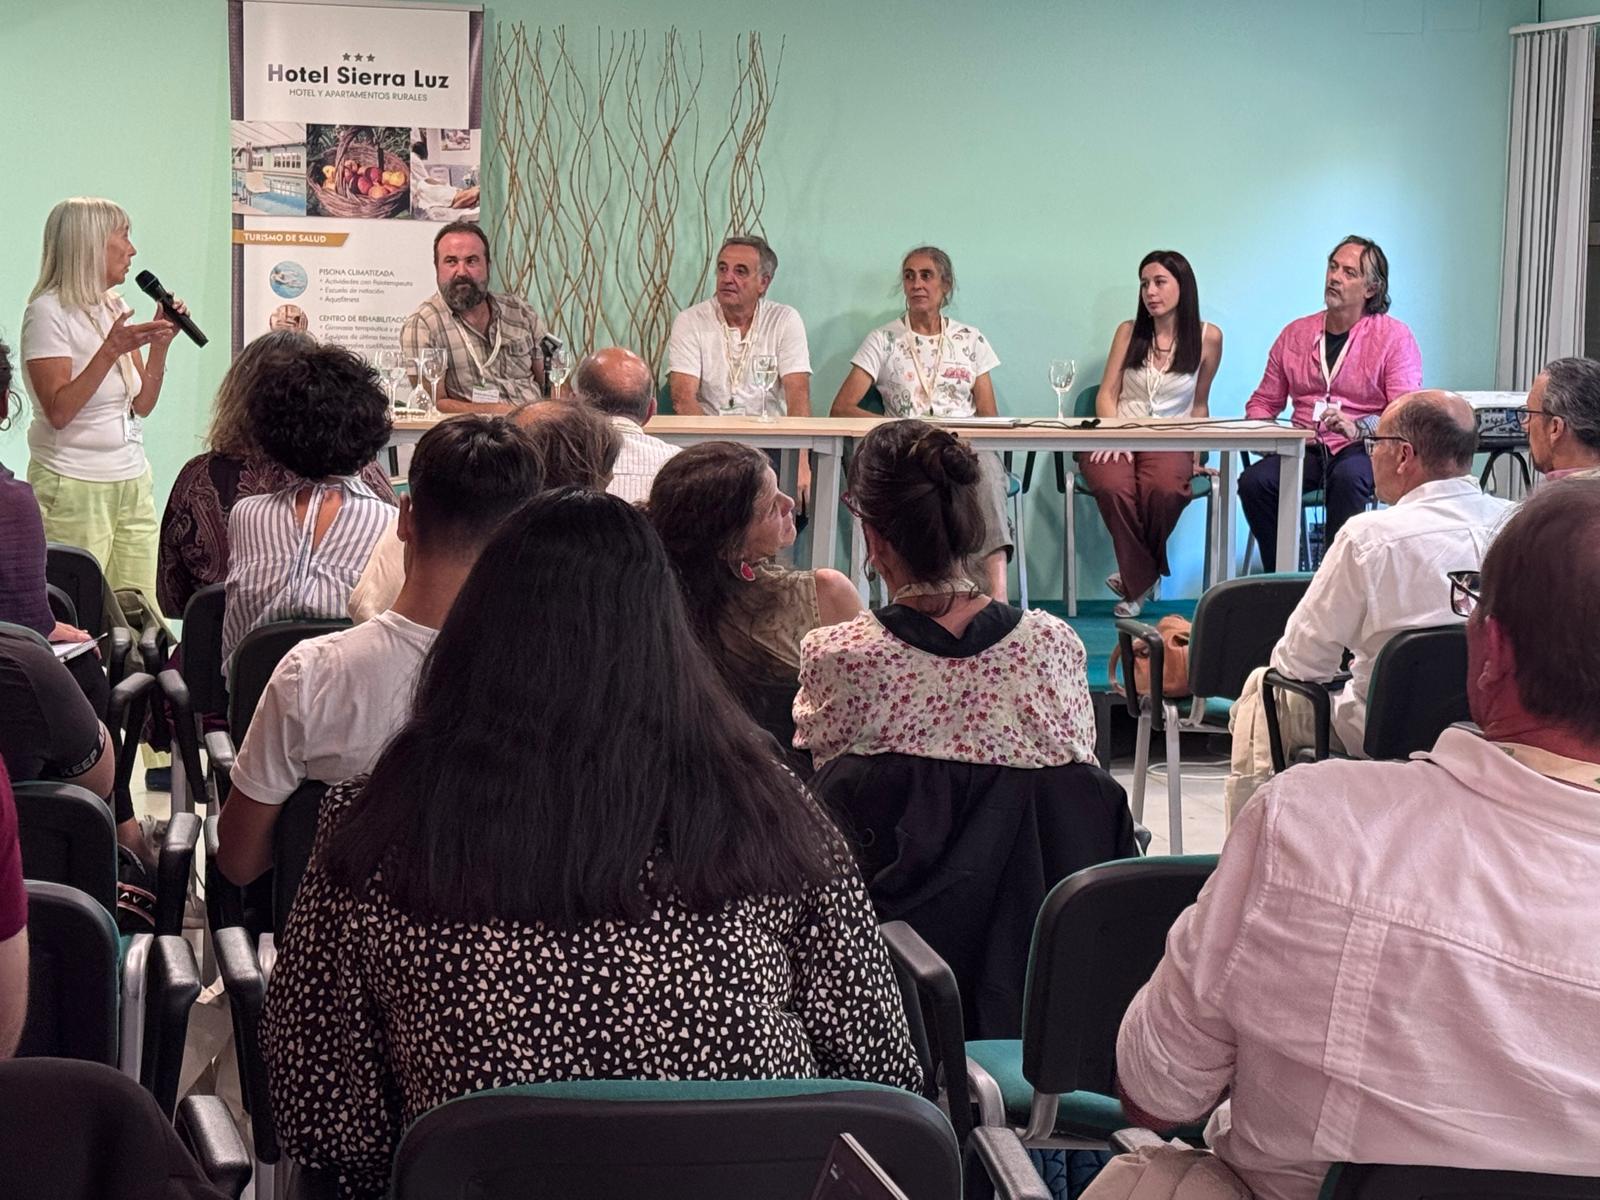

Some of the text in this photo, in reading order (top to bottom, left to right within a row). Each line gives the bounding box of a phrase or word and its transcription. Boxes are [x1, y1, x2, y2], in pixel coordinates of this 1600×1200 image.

[267, 63, 449, 88] Hotel Sierra Luz
[289, 88, 428, 102] HOTEL Y APARTAMENTOS RURALES
[243, 232, 327, 243] TURISMO DE SALUD
[319, 268, 395, 277] PISCINA CLIMATIZADA
